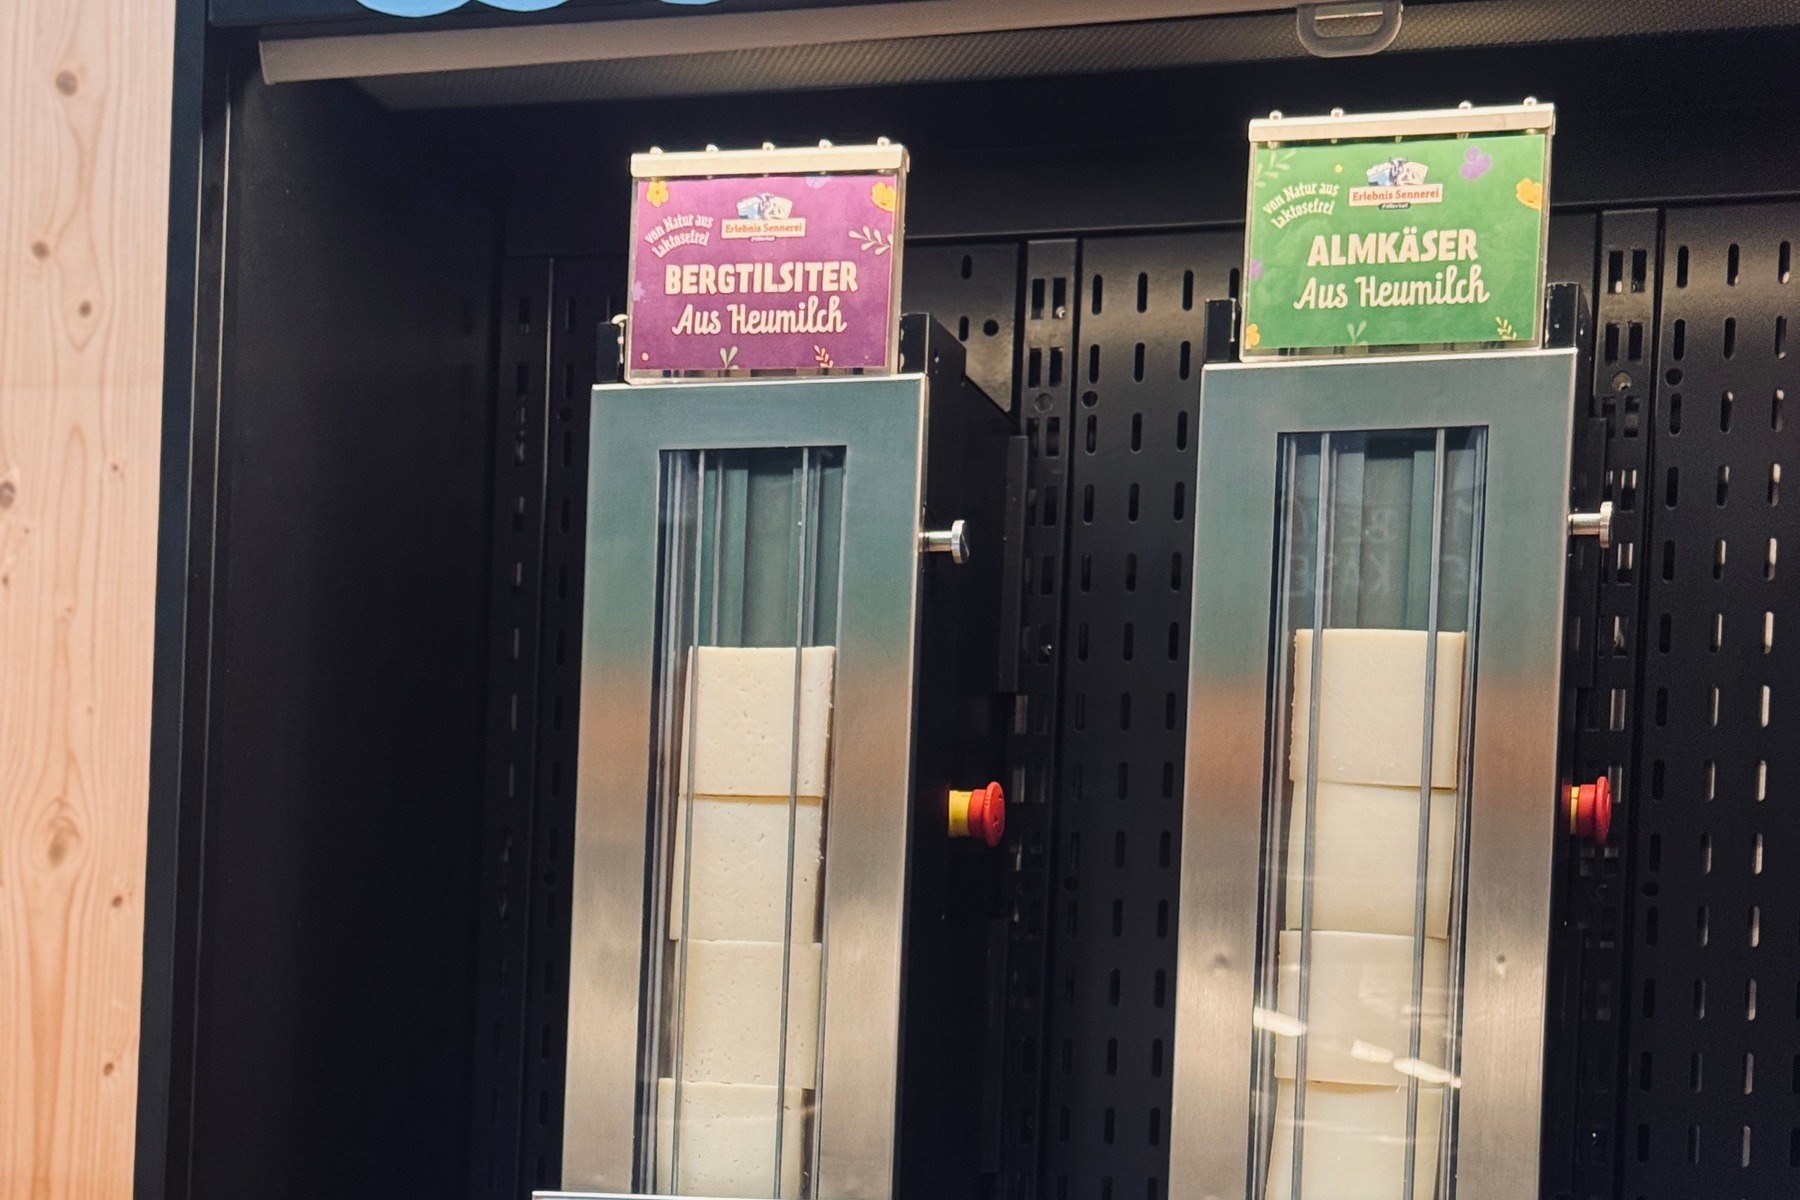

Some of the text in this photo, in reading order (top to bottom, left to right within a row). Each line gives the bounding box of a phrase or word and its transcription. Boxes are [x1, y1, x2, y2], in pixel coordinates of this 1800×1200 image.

[1262, 182, 1340, 214] von Natur aus
[1352, 188, 1438, 201] Erlebnis Sennerei
[644, 214, 714, 244] von Natur aus
[725, 222, 802, 233] Erlebnis Sennerei
[1307, 226, 1478, 267] ALMKÄSER
[664, 262, 859, 295] BERGTILSITER
[1293, 264, 1490, 310] Aus Heumilch
[672, 296, 847, 335] Aus Heumilch
